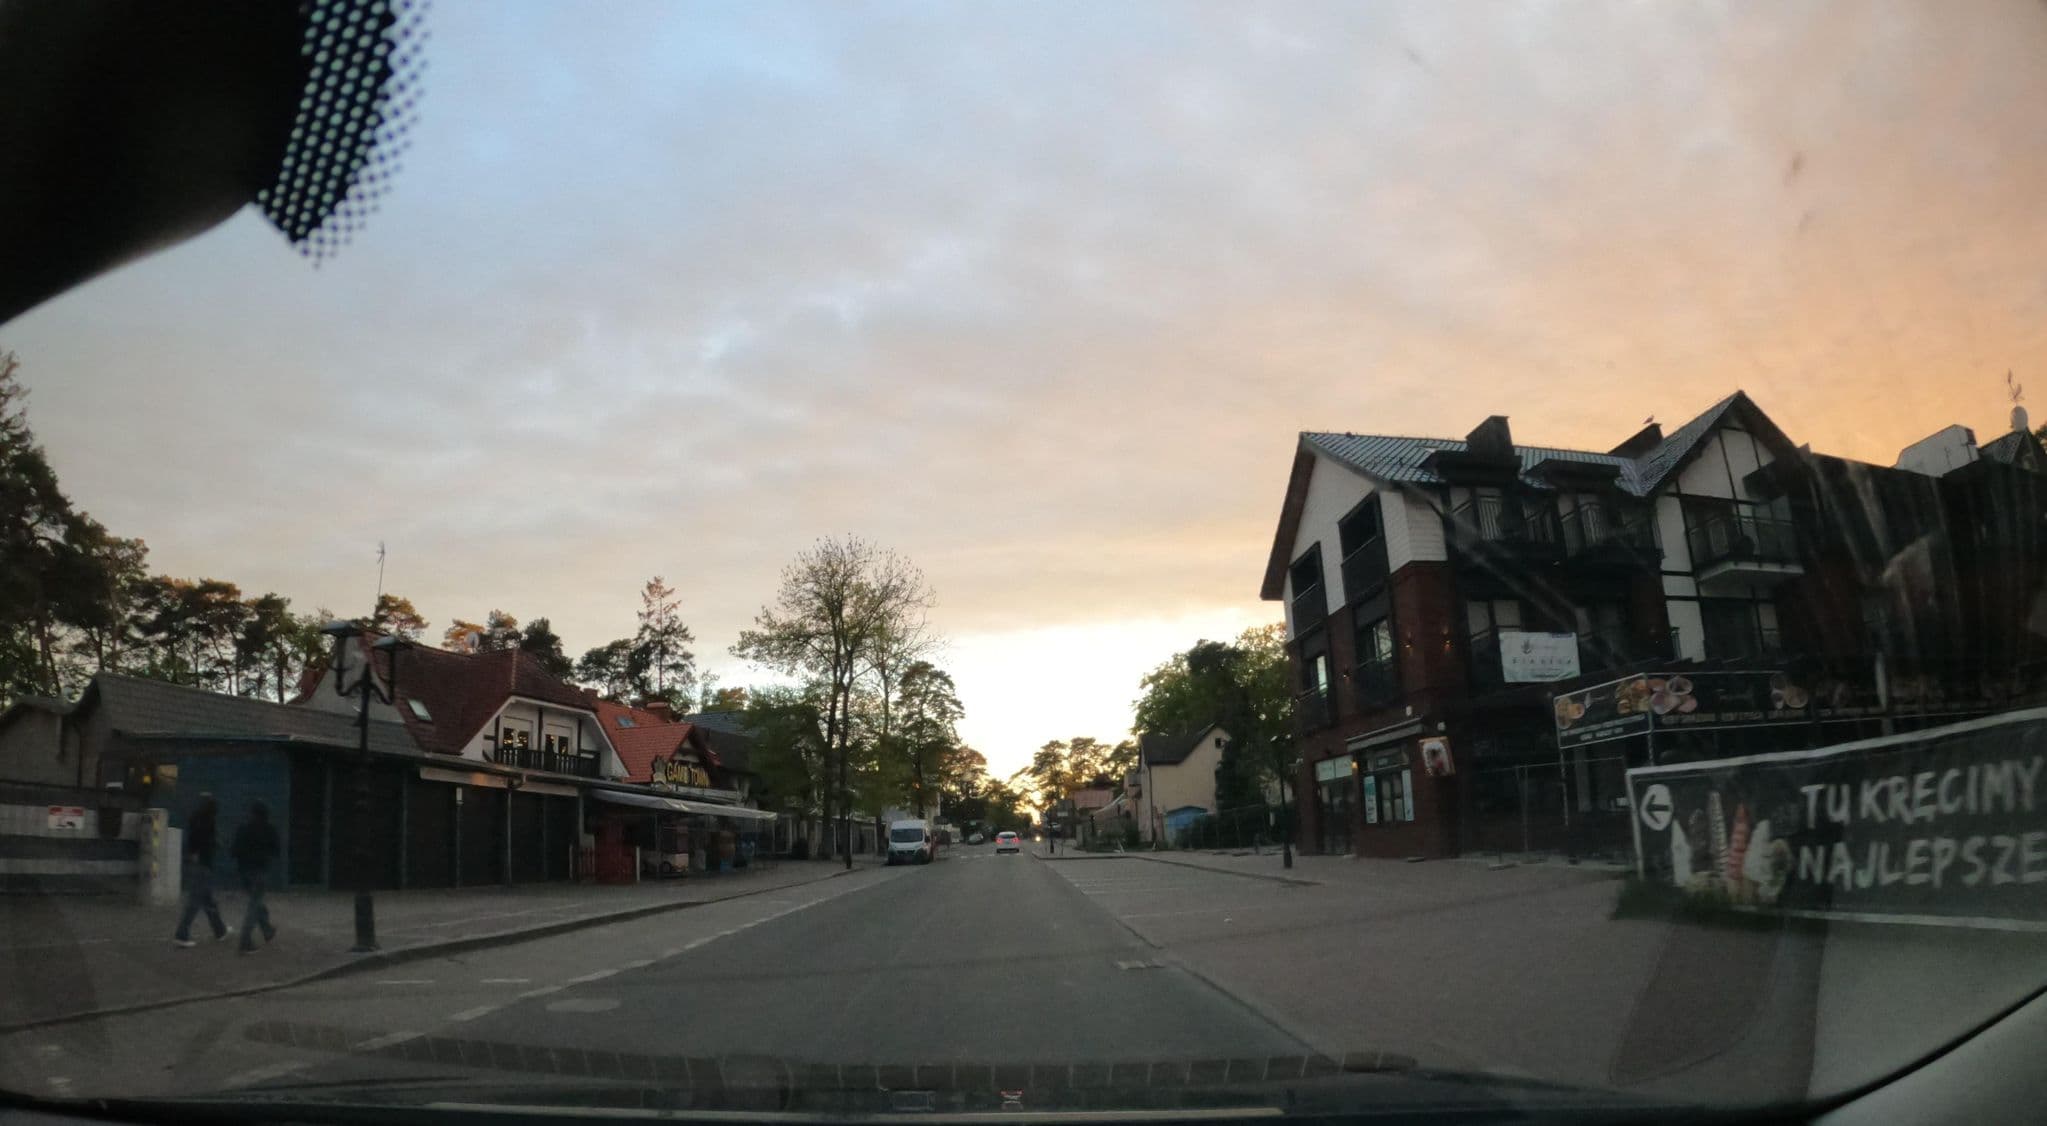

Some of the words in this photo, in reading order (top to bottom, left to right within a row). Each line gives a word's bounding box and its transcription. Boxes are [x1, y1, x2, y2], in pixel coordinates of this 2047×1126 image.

[1800, 784, 1851, 829] TU
[1861, 756, 2045, 825] KRĘCIMY
[1799, 832, 2047, 892] NAJLEPSZE
